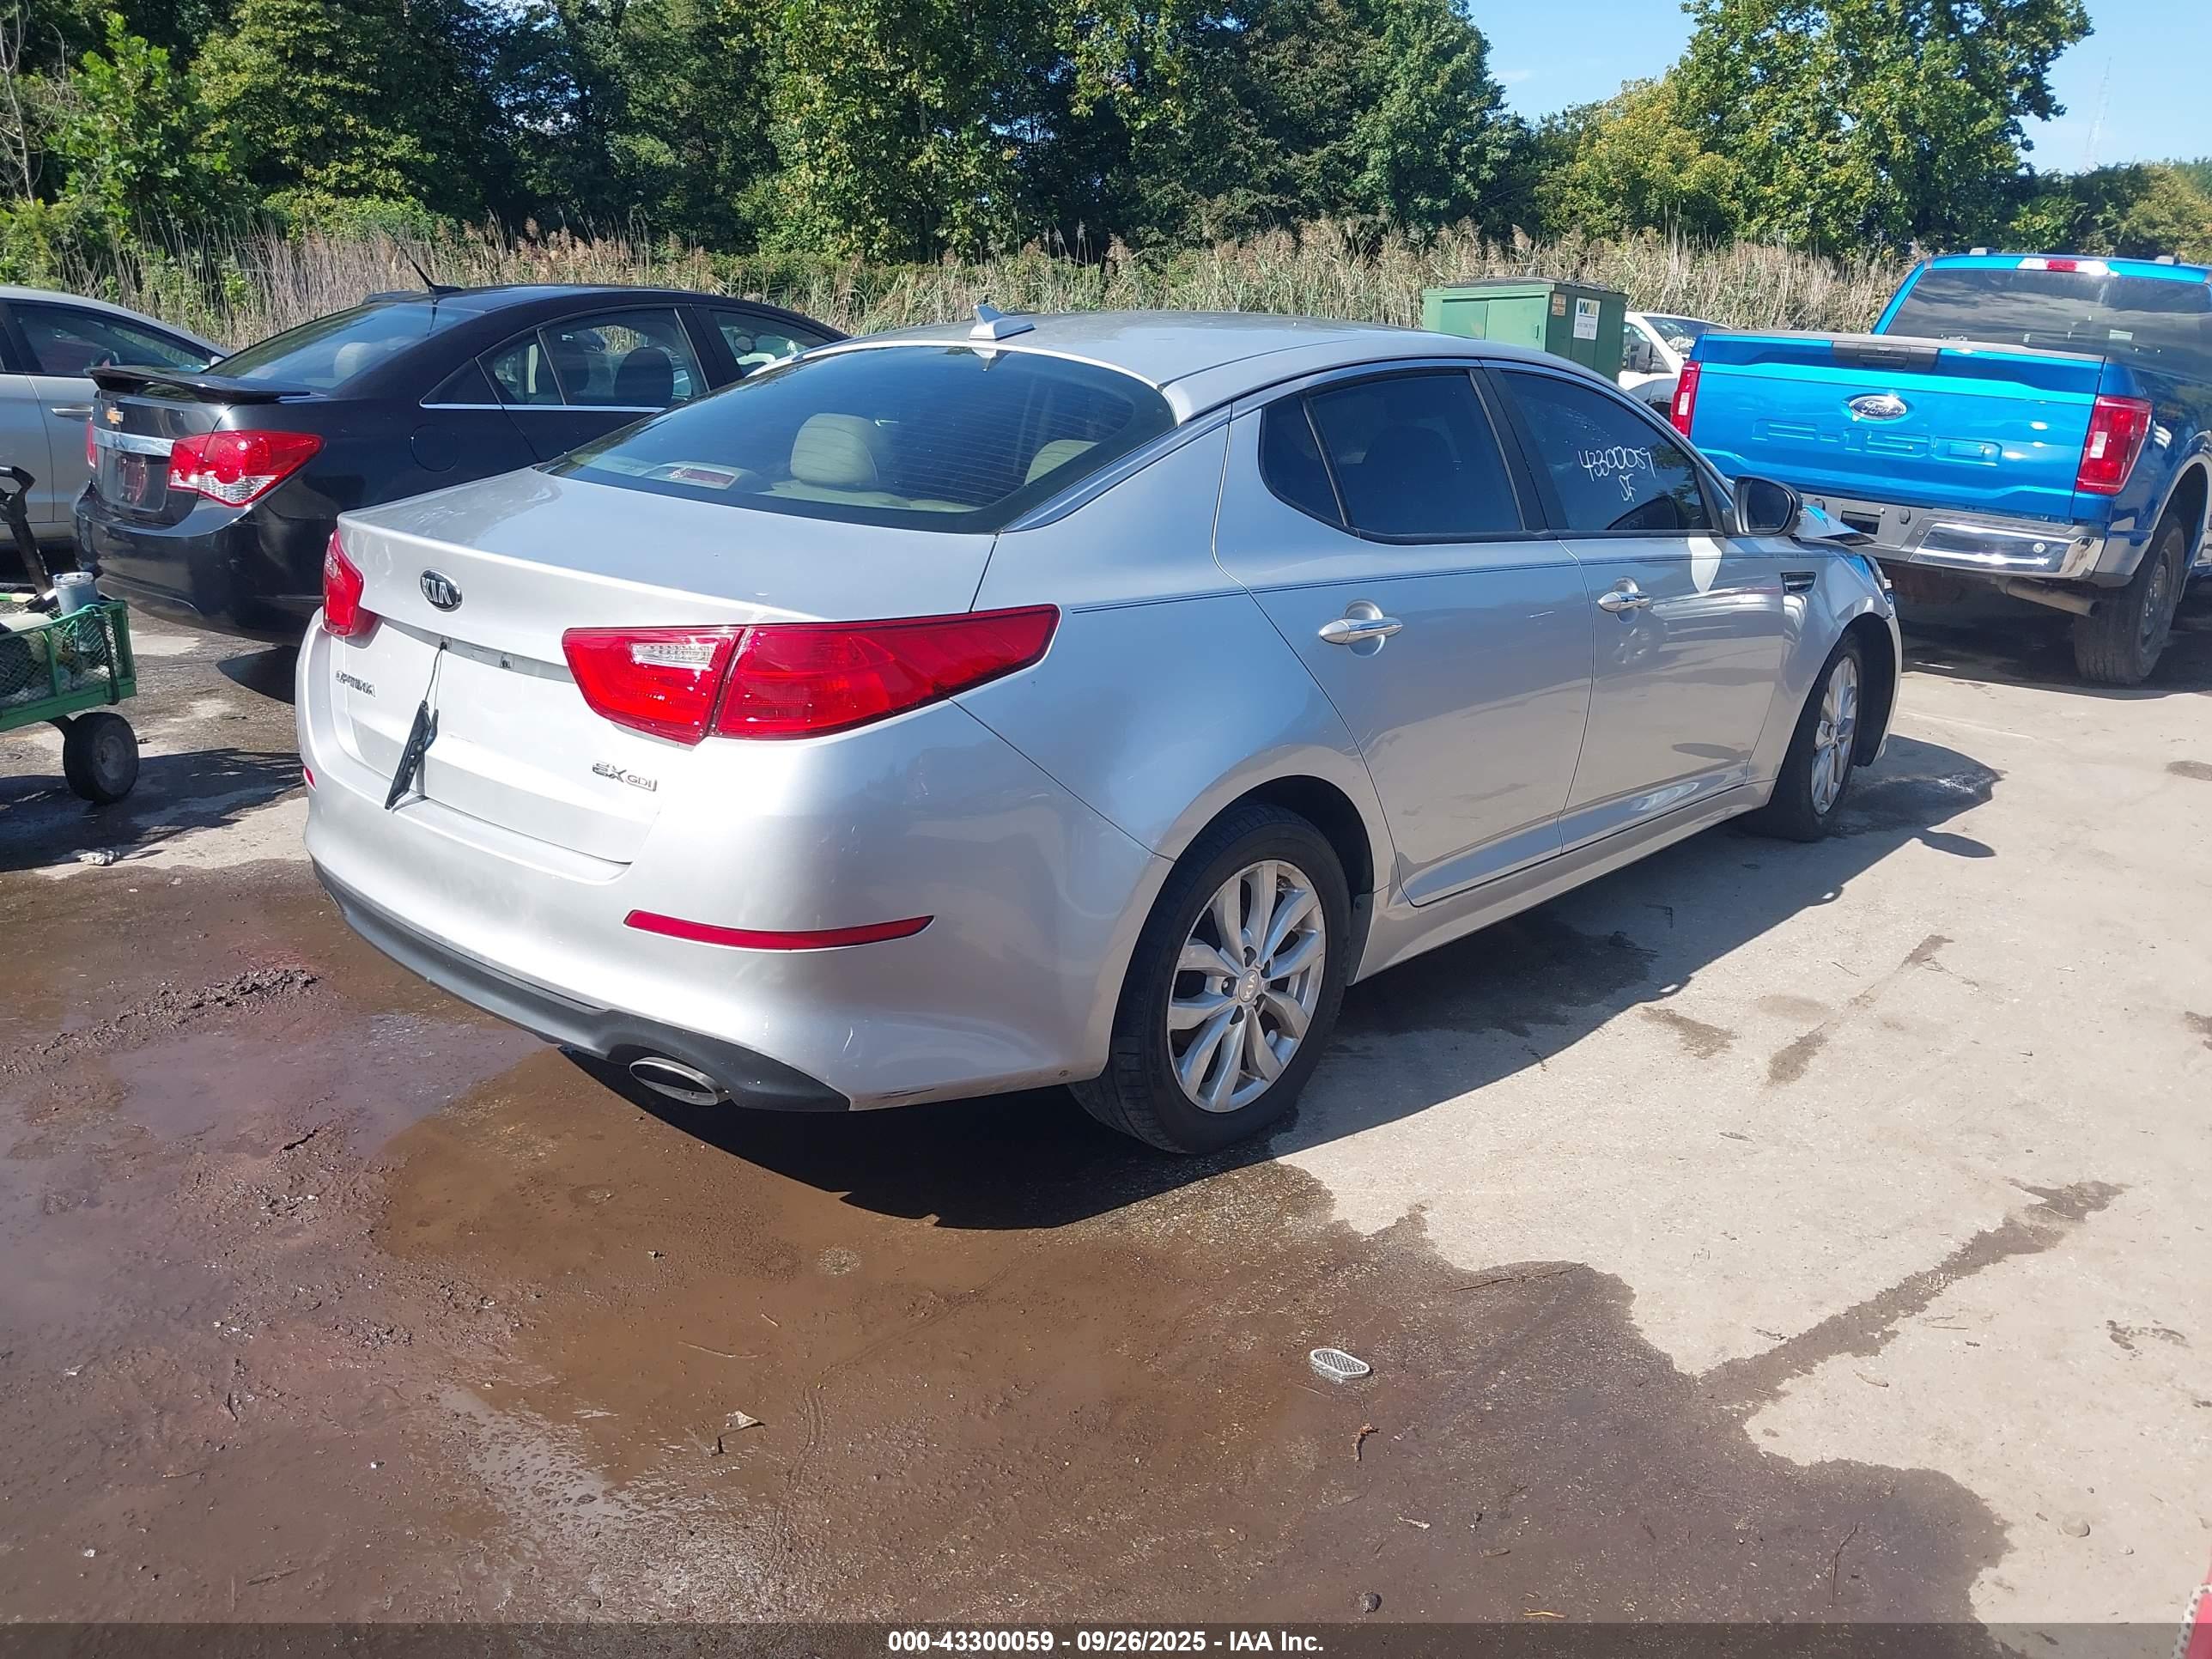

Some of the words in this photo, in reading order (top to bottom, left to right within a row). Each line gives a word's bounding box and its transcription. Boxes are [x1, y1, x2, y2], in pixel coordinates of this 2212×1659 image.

[1752, 418, 2002, 467] F-150
[1577, 446, 1656, 482] 43300059
[421, 576, 453, 605] KIA
